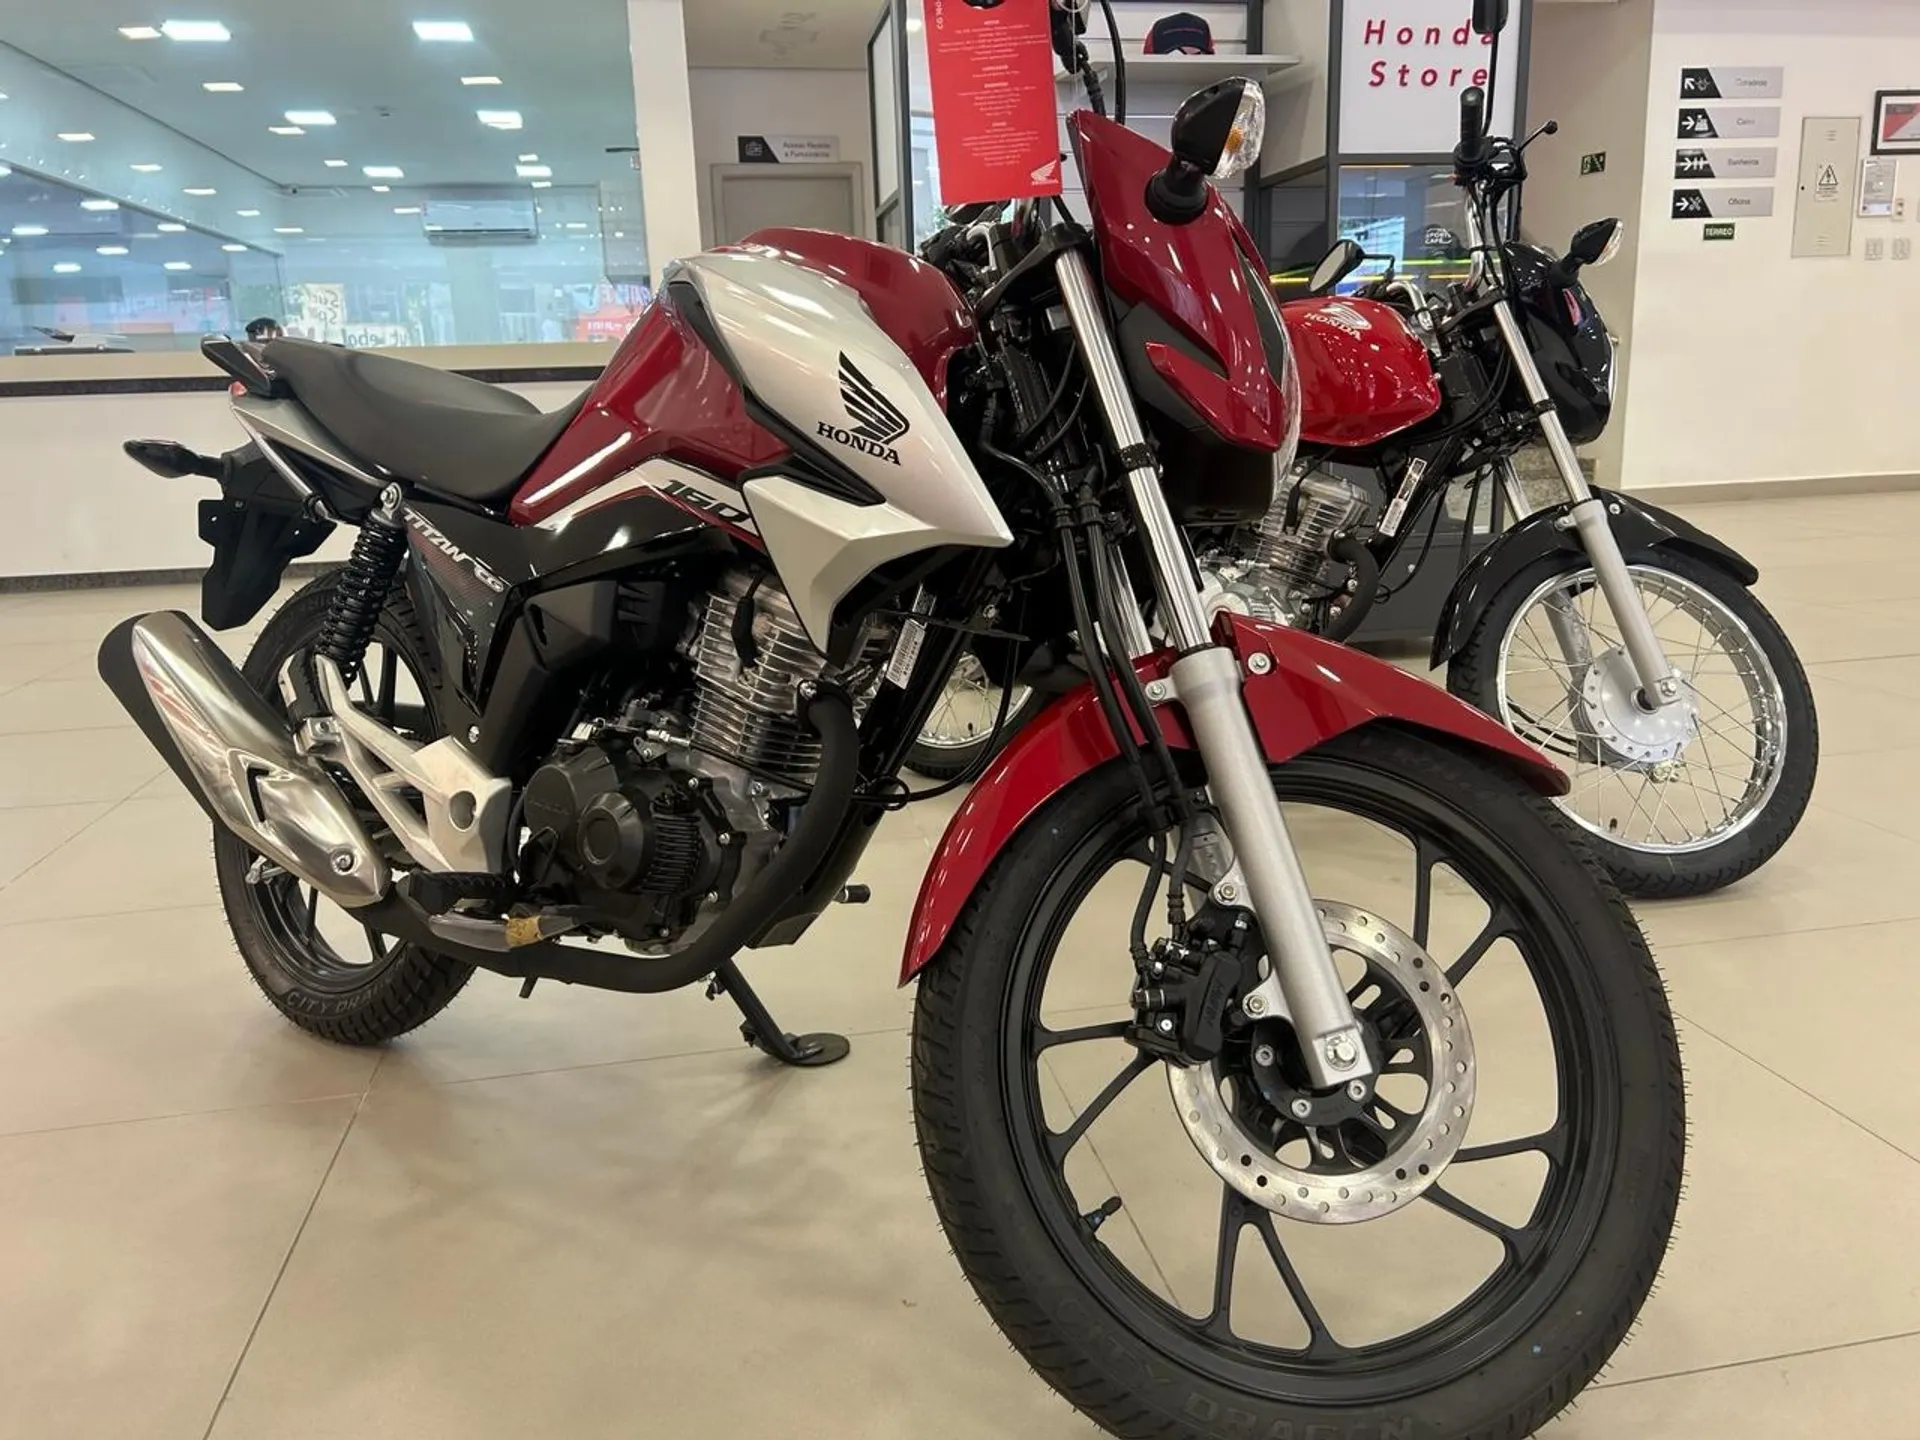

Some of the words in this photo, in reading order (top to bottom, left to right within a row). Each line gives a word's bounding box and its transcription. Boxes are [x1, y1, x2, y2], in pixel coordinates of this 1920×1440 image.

[1364, 19, 1494, 45] Honda
[1368, 61, 1488, 87] Store
[1304, 312, 1361, 341] HONDA
[816, 421, 901, 466] HONDA
[651, 480, 751, 523] 160
[404, 506, 469, 562] TITAN
[288, 991, 329, 1014] CITY
